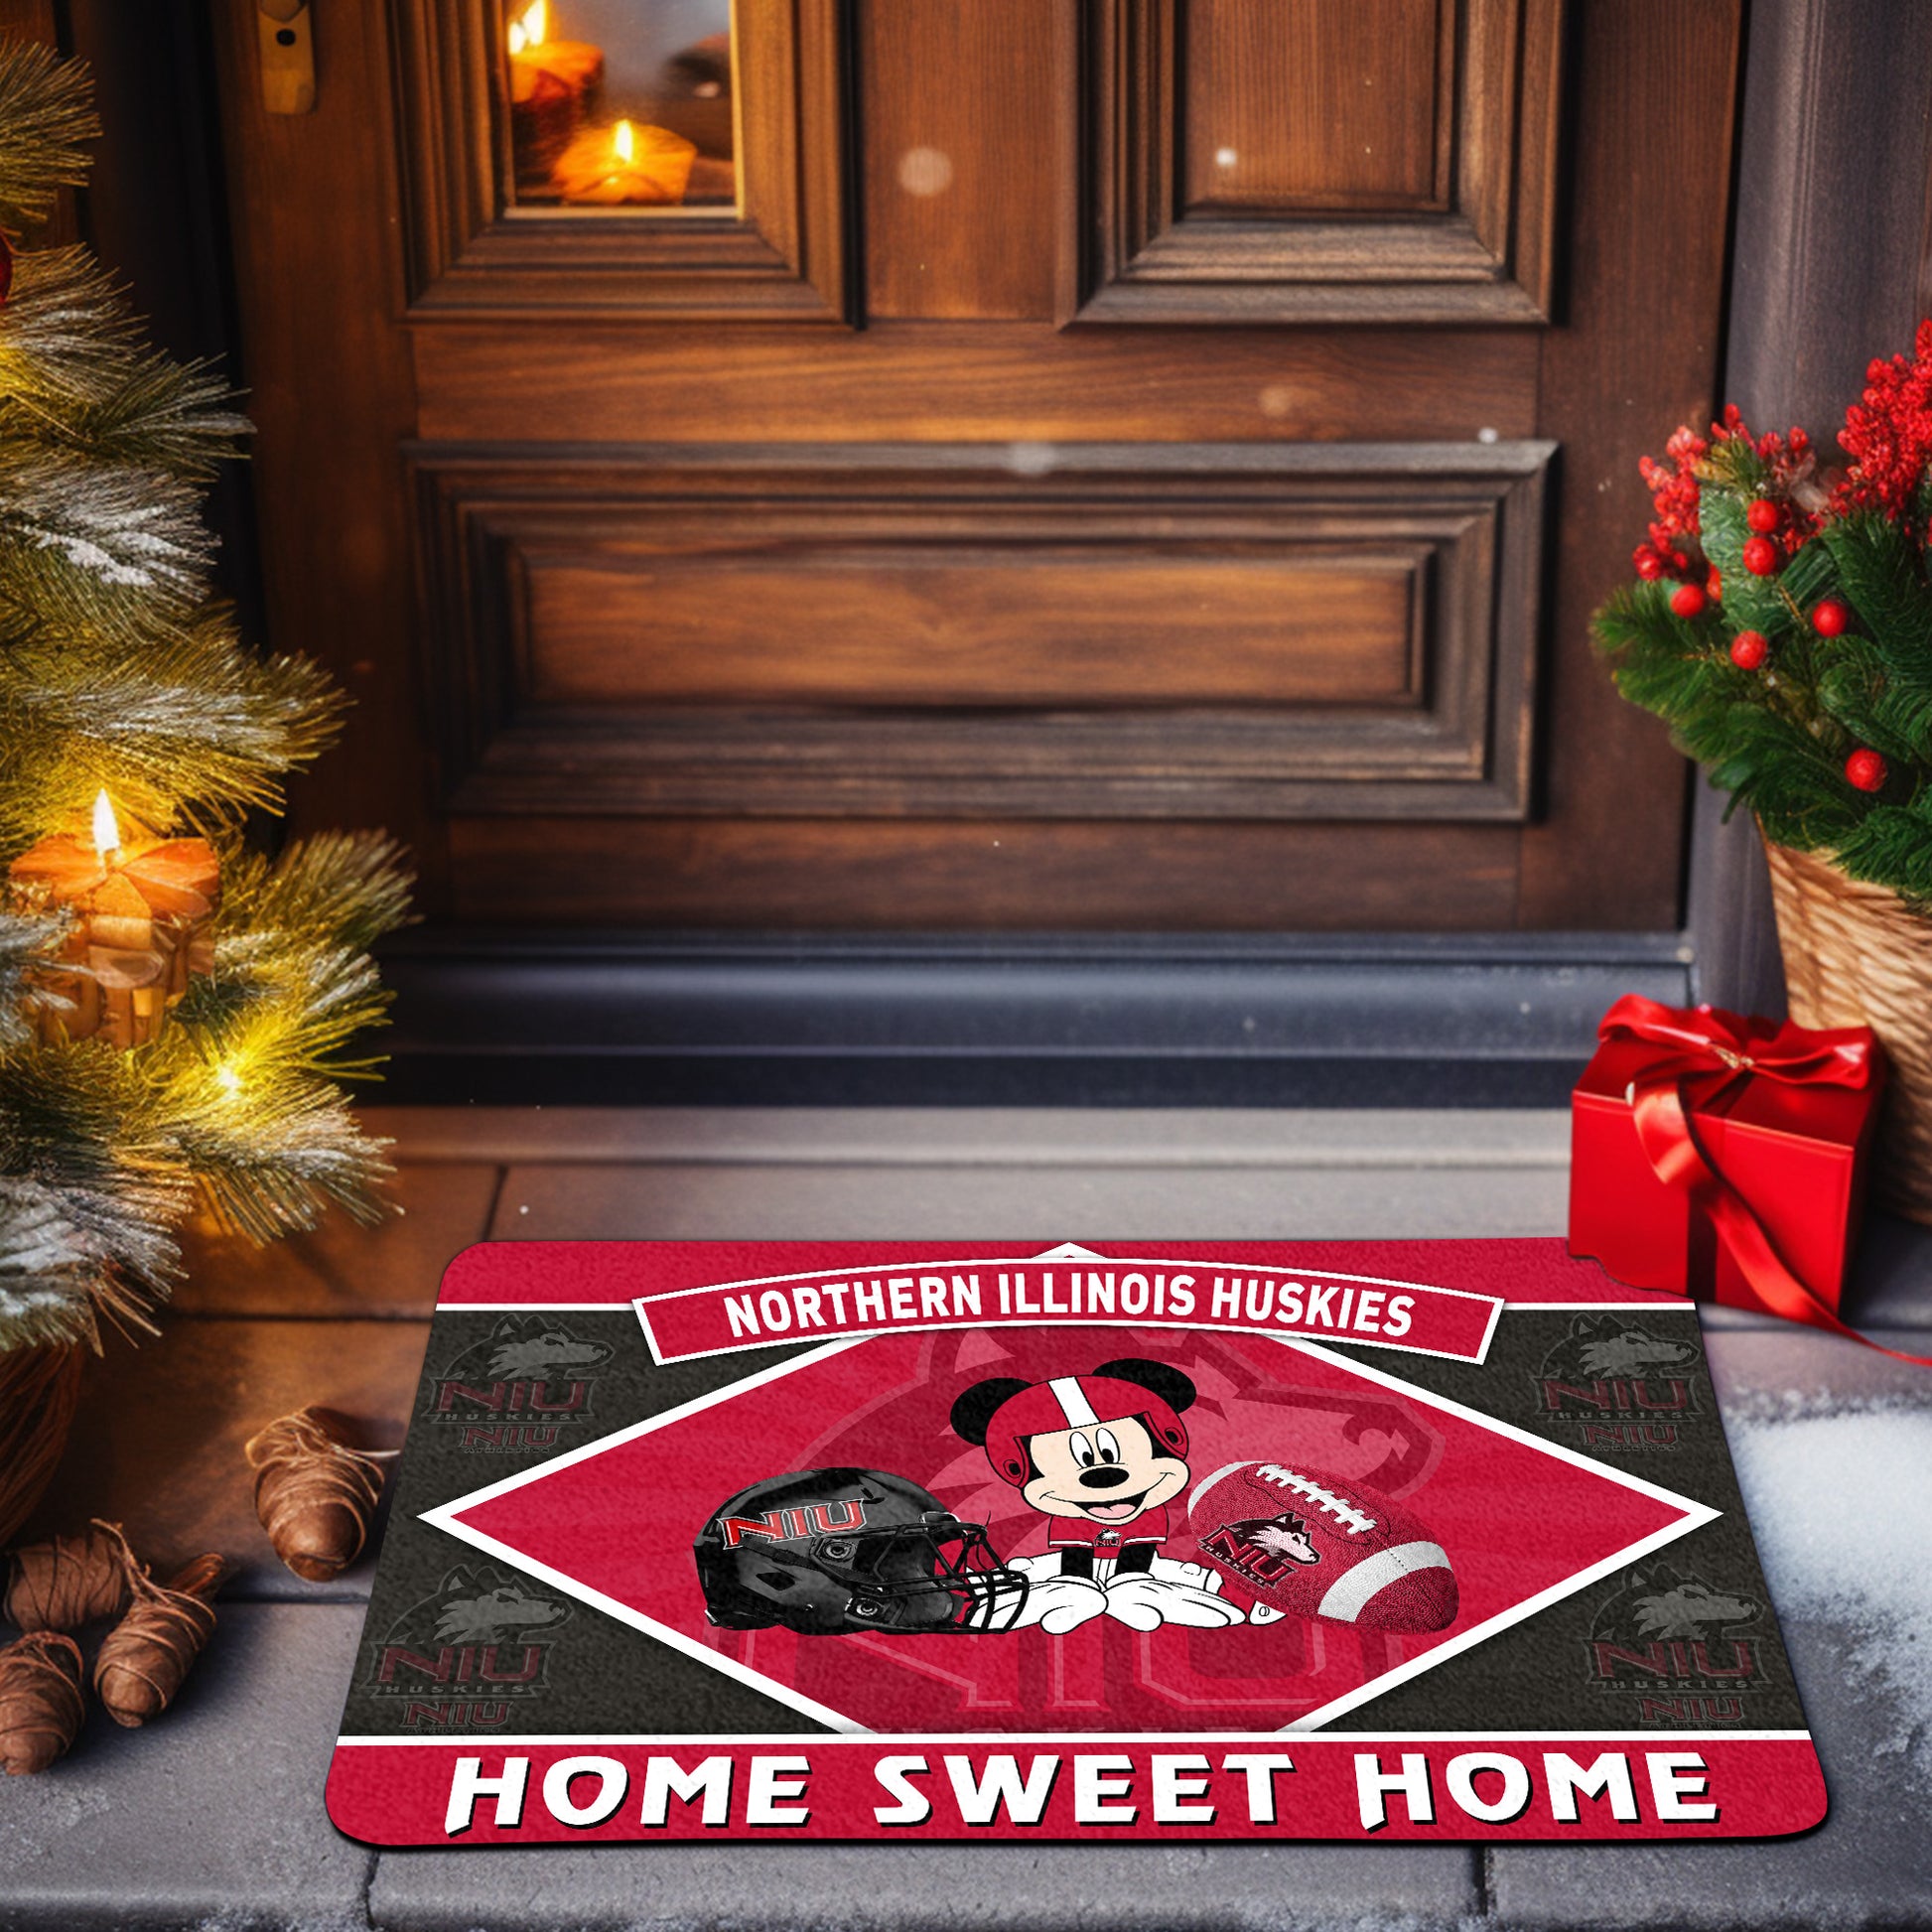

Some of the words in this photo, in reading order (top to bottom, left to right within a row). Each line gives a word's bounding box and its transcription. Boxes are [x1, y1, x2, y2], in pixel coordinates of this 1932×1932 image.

[723, 1274, 982, 1337] NORTHERN
[998, 1272, 1196, 1316] ILLINOIS
[1210, 1277, 1416, 1337] HUSKIES
[435, 1380, 586, 1412] NIU
[1542, 1379, 1688, 1411] NIU
[444, 1412, 571, 1422] HUSKIES
[1559, 1411, 1684, 1421] HUSKIES
[460, 1426, 560, 1448] NIU
[1584, 1424, 1678, 1446] NIU
[718, 1498, 868, 1550] NIU
[1206, 1528, 1290, 1582] NIU
[376, 1646, 542, 1684] NIU
[1591, 1641, 1754, 1679] NIU
[385, 1685, 526, 1694] HUSKIES
[1611, 1679, 1749, 1690] HUSKIES
[402, 1701, 512, 1727] NIU
[1638, 1697, 1744, 1723] NIU
[444, 1755, 813, 1837] HOME
[873, 1754, 1295, 1827] SWEET
[1353, 1752, 1720, 1832] HOME
